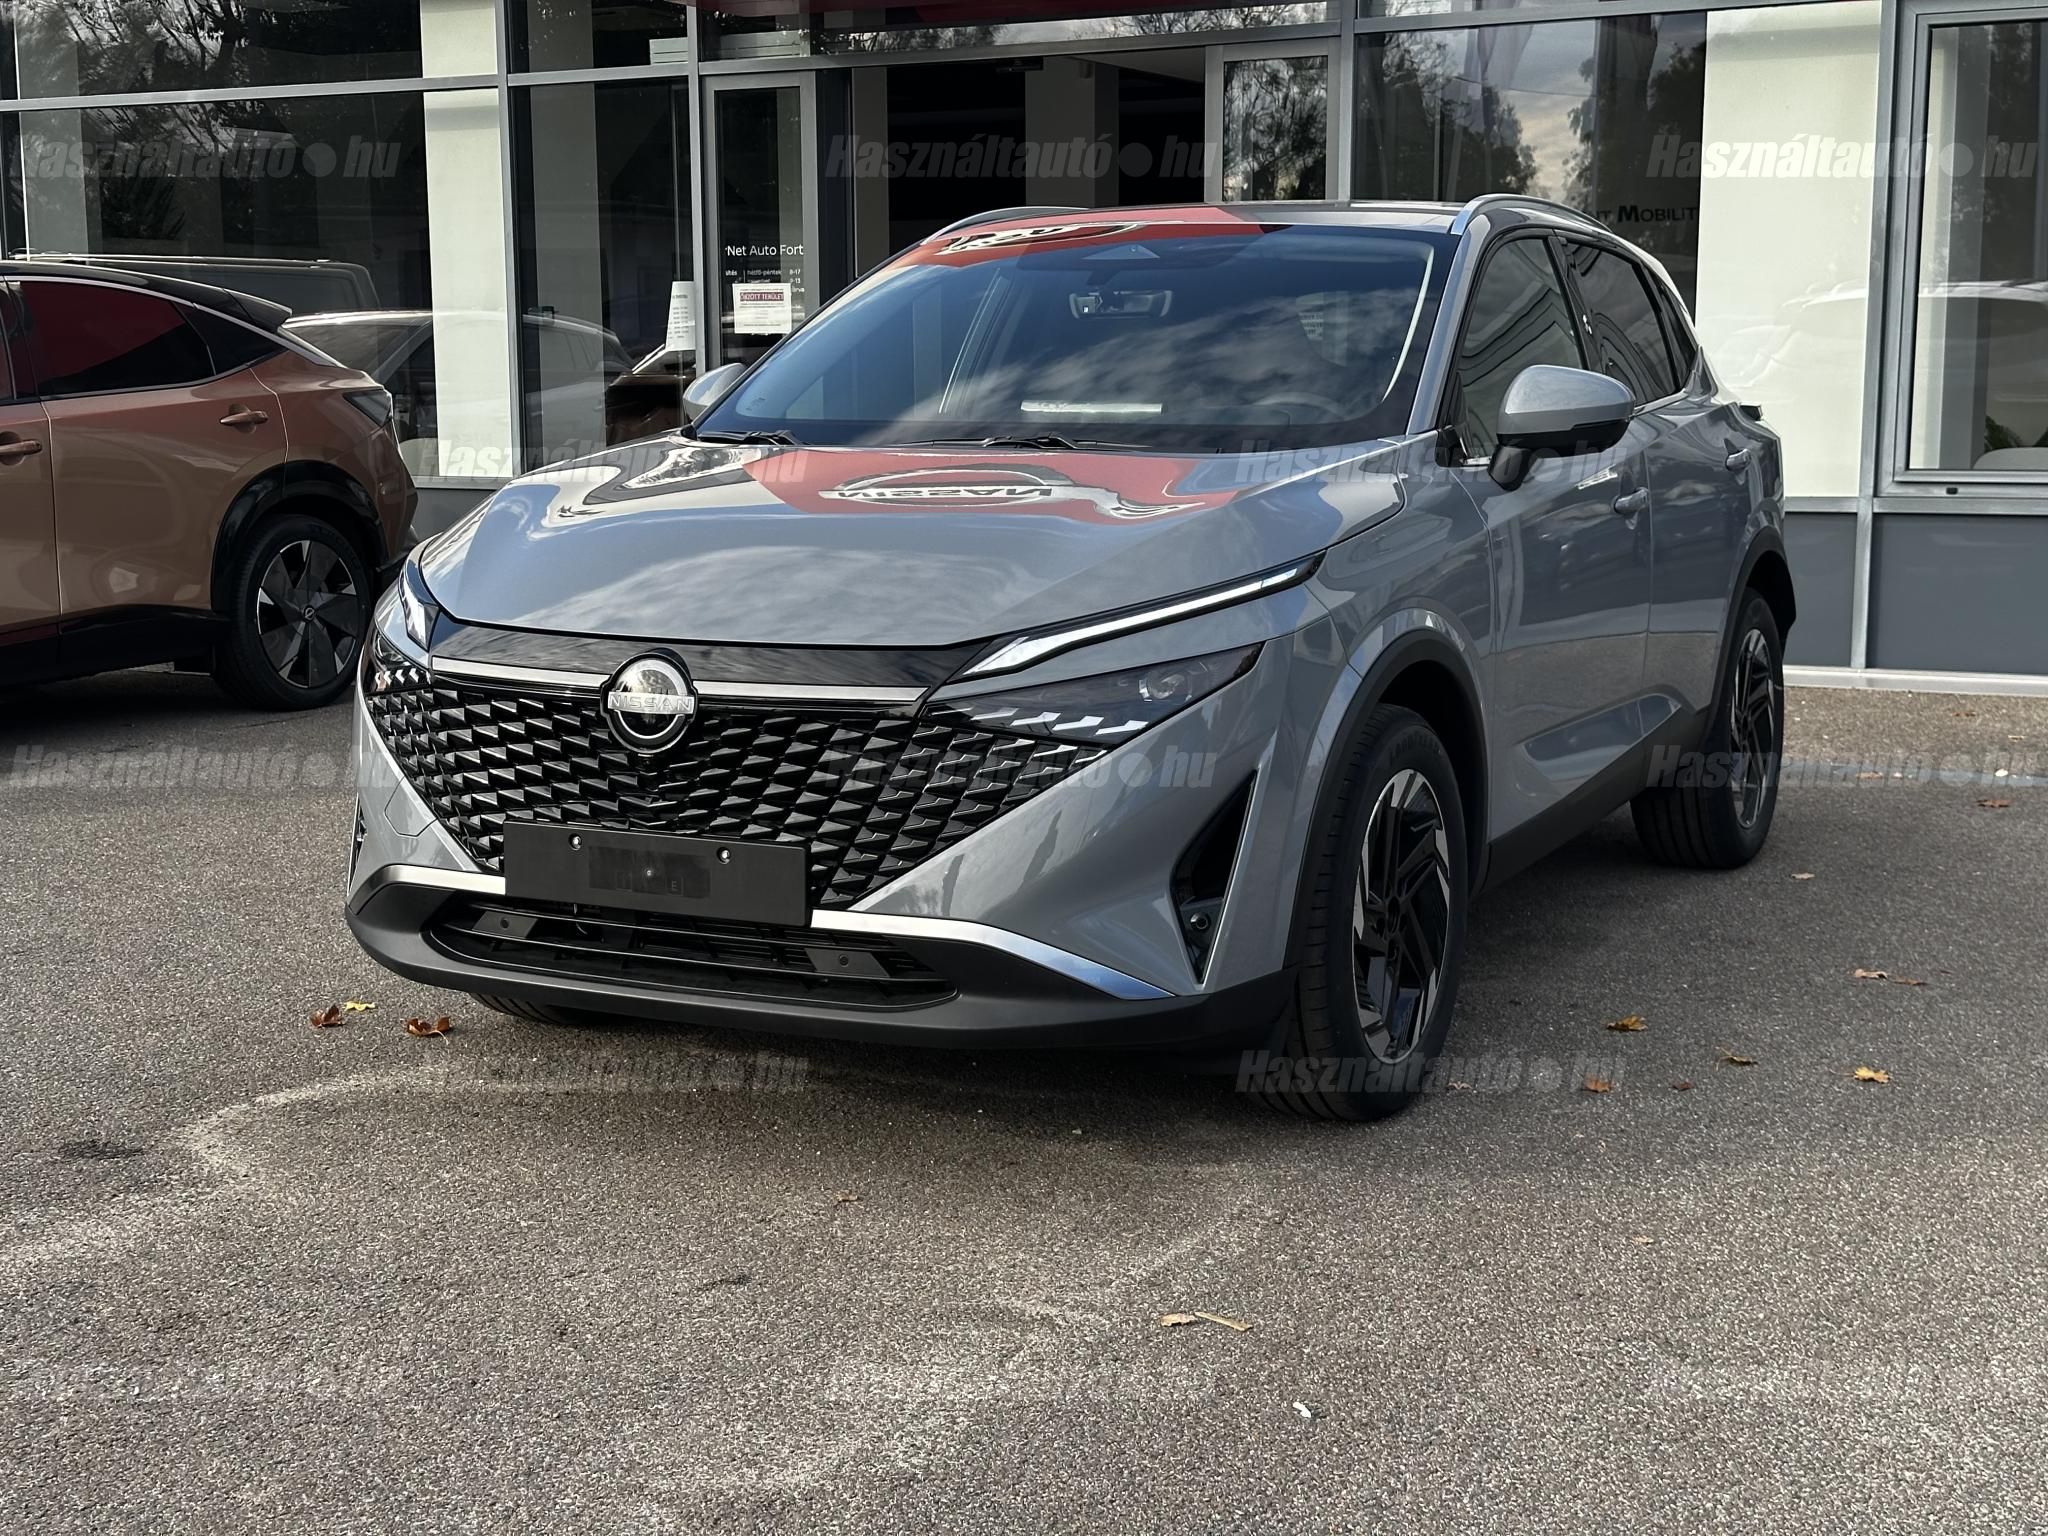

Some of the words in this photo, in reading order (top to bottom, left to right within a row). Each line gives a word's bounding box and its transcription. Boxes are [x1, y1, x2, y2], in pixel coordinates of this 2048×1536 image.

[749, 245, 777, 256] Auto
[780, 243, 804, 256] Fort
[609, 694, 694, 712] NISSAN
